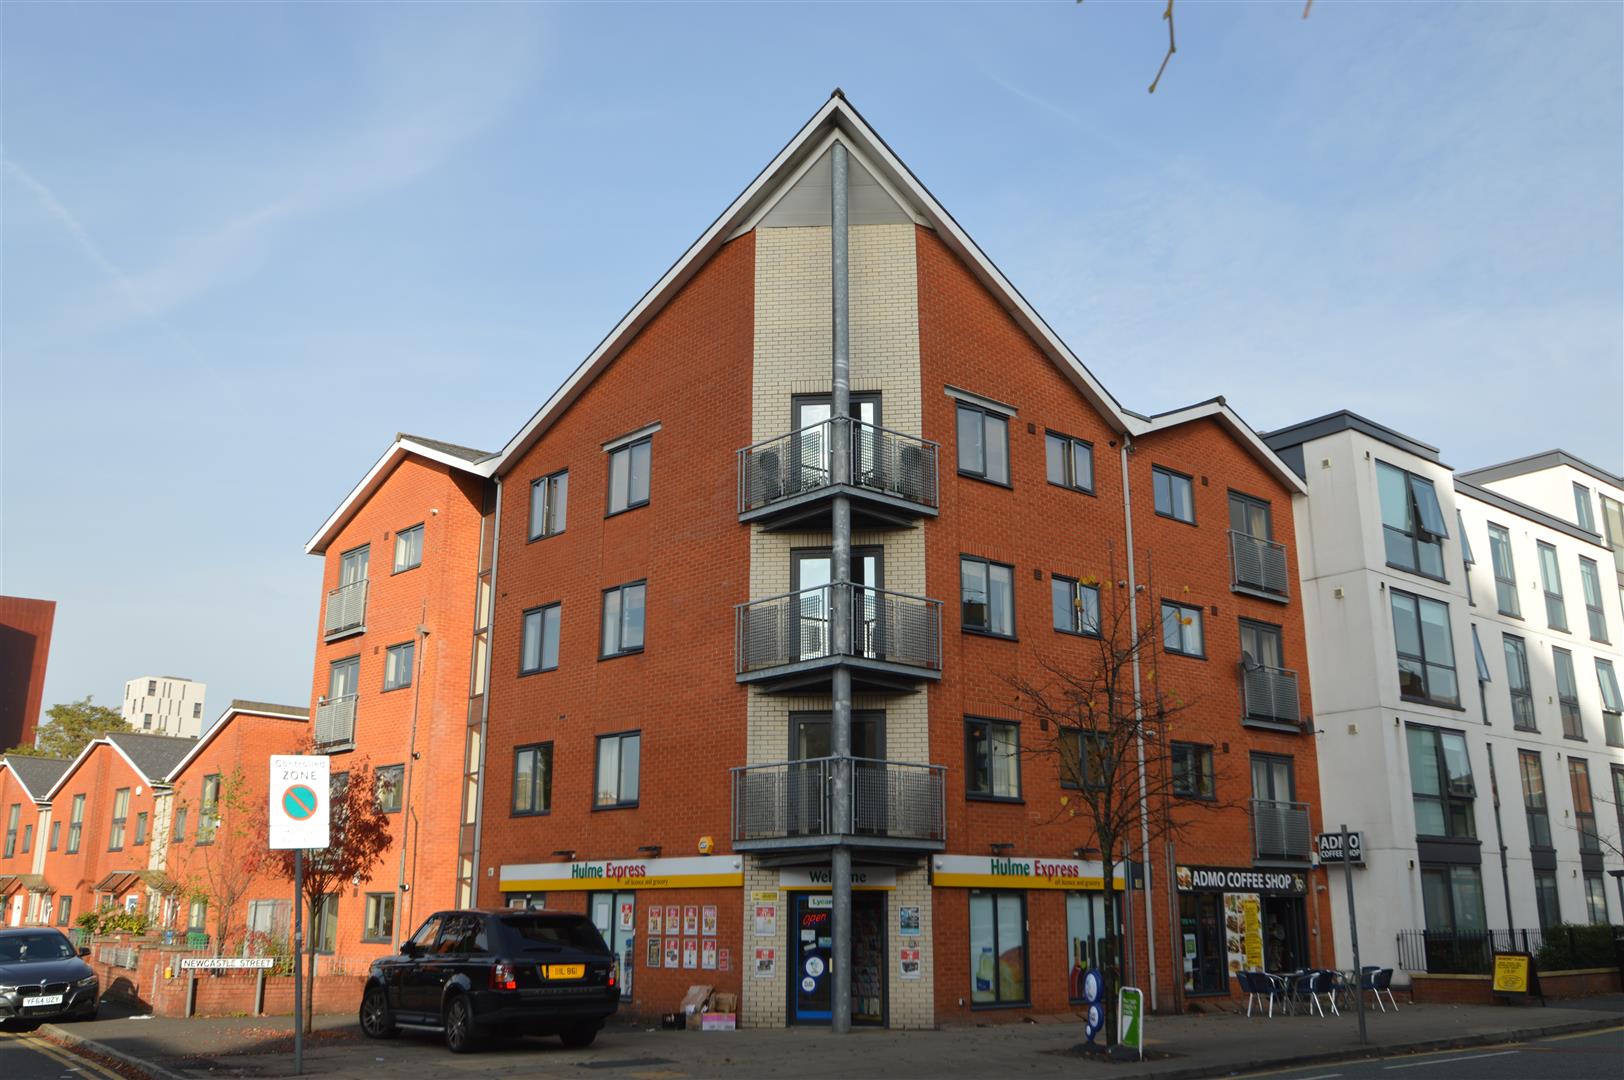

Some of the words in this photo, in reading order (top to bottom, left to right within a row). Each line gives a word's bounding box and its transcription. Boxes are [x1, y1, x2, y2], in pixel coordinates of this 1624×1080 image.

[282, 770, 317, 781] ZONE
[1321, 849, 1344, 859] COFFEE
[572, 862, 603, 879] Hulme
[606, 862, 646, 882] Express
[991, 858, 1030, 876] Hulme
[1034, 859, 1079, 881] Express
[809, 870, 867, 884] Welme
[1193, 870, 1226, 888] ADMO
[1227, 872, 1263, 889] COFFEE
[1265, 873, 1292, 890] SHOP
[183, 958, 237, 968] NEWCASTLE
[240, 958, 271, 968] STREET
